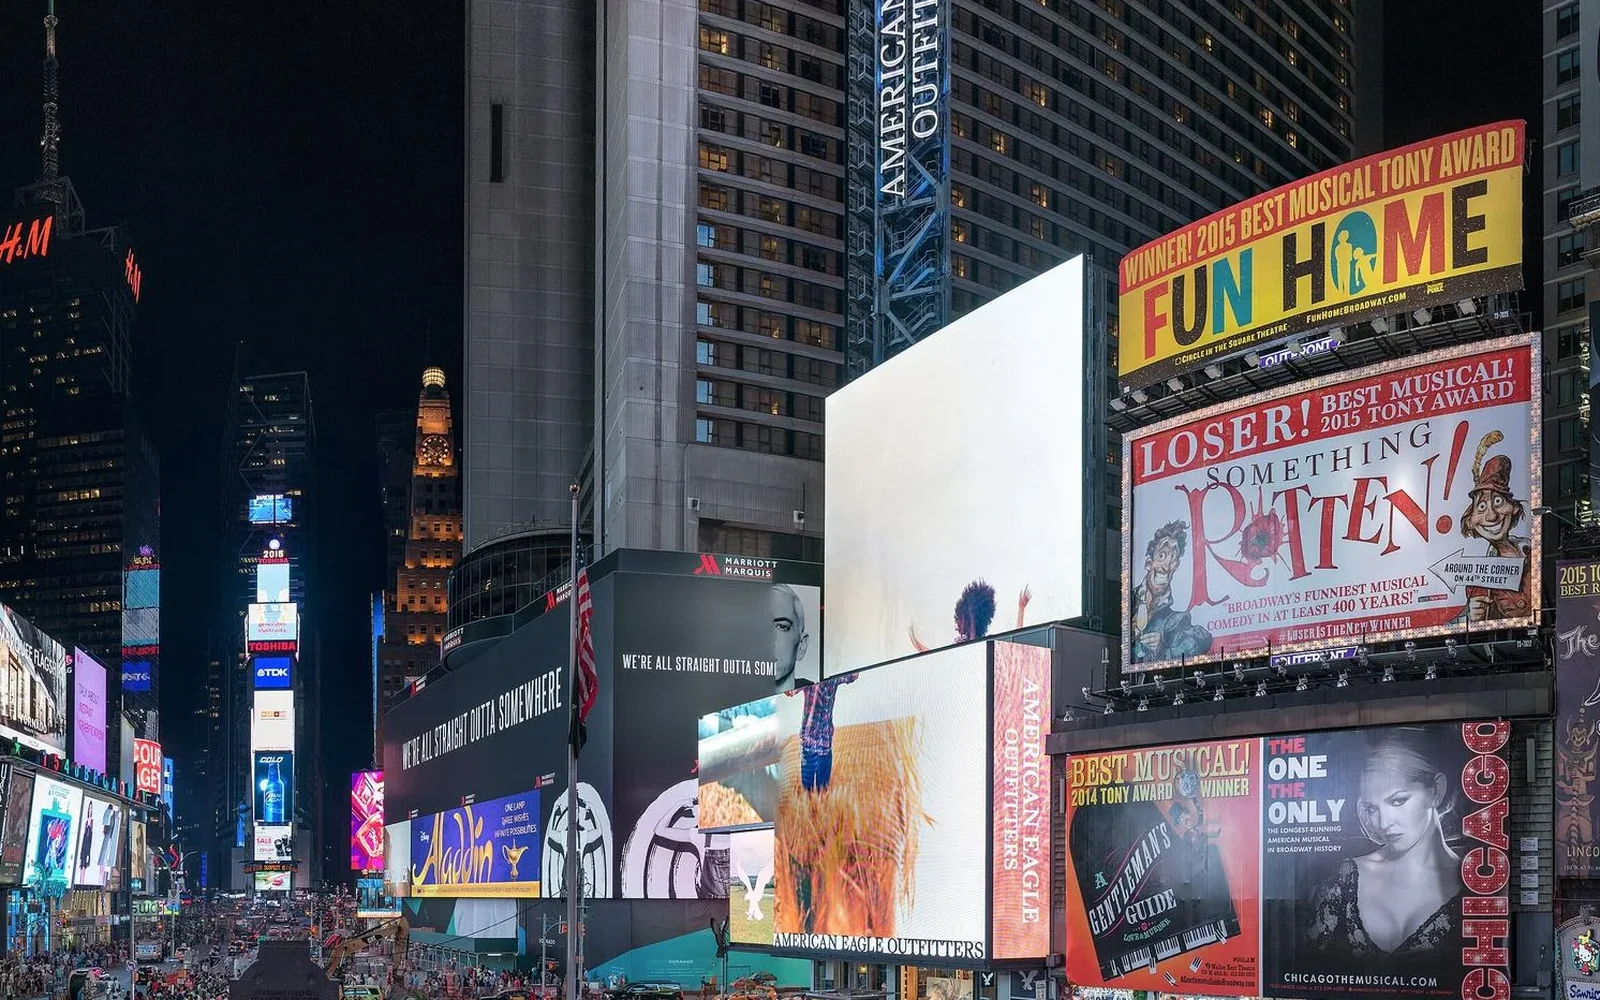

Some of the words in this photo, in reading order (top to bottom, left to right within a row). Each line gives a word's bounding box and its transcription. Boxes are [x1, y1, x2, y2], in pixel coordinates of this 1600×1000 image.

[1124, 231, 1192, 288] WINNER!
[1197, 213, 1236, 258] 2015
[1240, 192, 1286, 241] BEST
[1289, 164, 1376, 222] MUSICAL
[1379, 147, 1434, 193] TONY
[1439, 128, 1515, 178] AWARD
[0, 216, 53, 264] H&M
[1144, 248, 1254, 360] FUN
[1182, 350, 1204, 365] CIRCLE
[1205, 348, 1214, 356] IN
[1214, 344, 1228, 354] THE
[1228, 334, 1256, 349] SQUARE
[1257, 323, 1288, 340] THEATRE
[1140, 399, 1310, 478] LOSER!
[1320, 385, 1381, 414] BEST
[1390, 358, 1513, 400] MUSICAL!
[1320, 412, 1360, 433] 2015
[1368, 396, 1426, 422] TONY
[1432, 382, 1515, 410] AWARD
[1207, 420, 1432, 490] SOMETHING
[264, 550, 284, 558] 2015
[724, 557, 778, 568] MARRIOTT
[724, 566, 772, 578] MARQUIS
[1444, 563, 1473, 574] AROUND
[1474, 564, 1488, 574] THE
[1490, 564, 1520, 576] CORNER
[1481, 576, 1508, 584] STREET
[1560, 566, 1586, 584] 2015
[1304, 584, 1367, 602] FUNNIEST
[1370, 575, 1429, 594] MUSICAL
[1560, 584, 1589, 596] BEST
[1207, 614, 1254, 632] COMEDY
[1258, 612, 1270, 624] IN
[1273, 608, 1289, 621] AT
[1292, 602, 1330, 619] LEAST
[1332, 598, 1356, 613] 400
[248, 642, 296, 650] TOSHIBA
[1558, 624, 1600, 660] The
[264, 668, 288, 676] TDK
[622, 654, 652, 670] WE'RE
[655, 656, 672, 671] ALL
[676, 656, 720, 673] STRAIGHT
[724, 659, 752, 675] OUTTA
[402, 736, 420, 770] WE'RE
[421, 730, 433, 763] ALL
[434, 712, 468, 758] STRAIGHT
[470, 700, 496, 742] OUTTA
[498, 666, 562, 732] SOMEWHERE
[1022, 677, 1040, 827] AMERICAN
[1268, 738, 1306, 754] THE
[1070, 754, 1128, 788] BEST
[1132, 742, 1250, 782] MUSICAL!
[1268, 755, 1328, 780] ONE
[1004, 728, 1018, 870] OUTFITTERS
[1071, 790, 1097, 806] 2014
[1100, 786, 1130, 806] TONY
[1132, 782, 1173, 802] AWARD
[1200, 778, 1249, 798] WINNER
[1268, 782, 1305, 798] THE
[1268, 798, 1346, 824] ONLY
[1280, 826, 1342, 834] LONGEST-RUNNING
[412, 805, 493, 885] Aladdin
[1461, 720, 1511, 1000] CHICAGO
[1022, 836, 1040, 924] EAGLE
[1088, 822, 1171, 935] GENTLEMAN'S
[1094, 871, 1108, 890] A
[1125, 888, 1178, 924] GUIDE
[774, 932, 838, 949] AMERICAN
[842, 935, 884, 953] EAGLE
[888, 937, 984, 958] OUTFITTERS
[1284, 972, 1438, 987] CHICAGOTHEMUSICAL.COM
